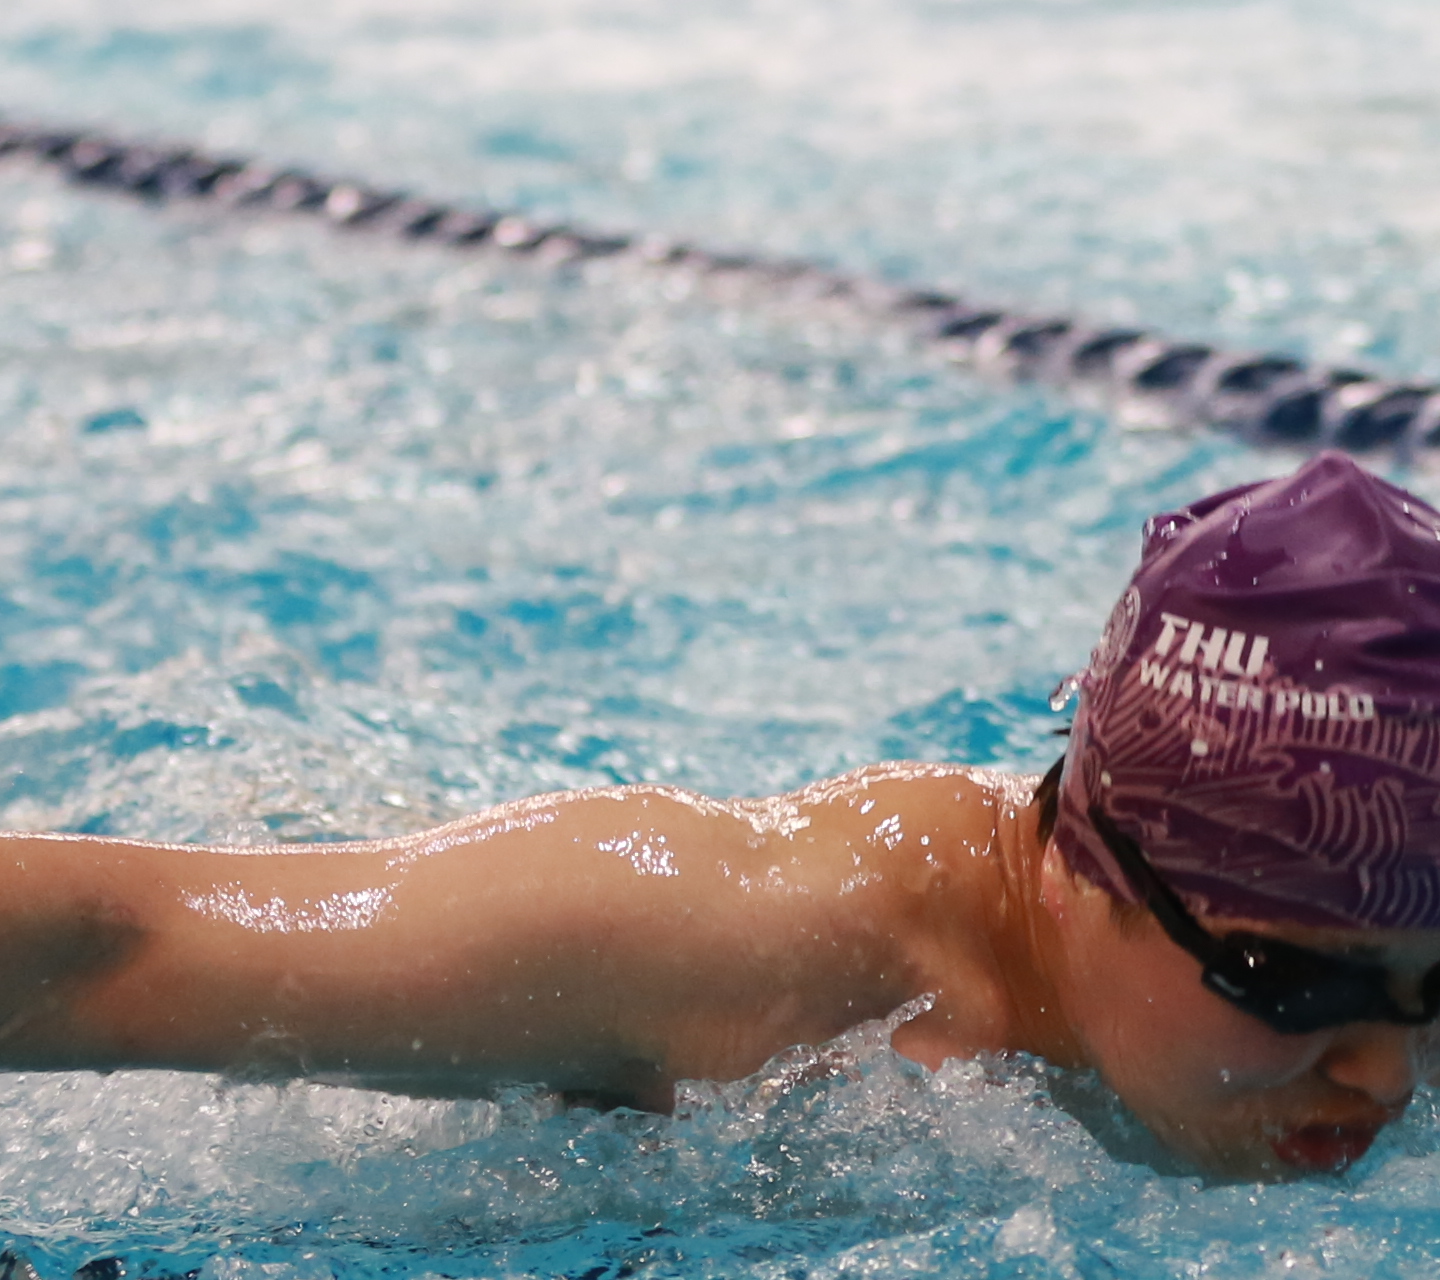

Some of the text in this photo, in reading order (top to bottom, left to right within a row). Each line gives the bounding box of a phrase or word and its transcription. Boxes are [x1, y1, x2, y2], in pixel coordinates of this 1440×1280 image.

[1154, 612, 1269, 677] THU
[1140, 658, 1374, 720] WATER POLO
